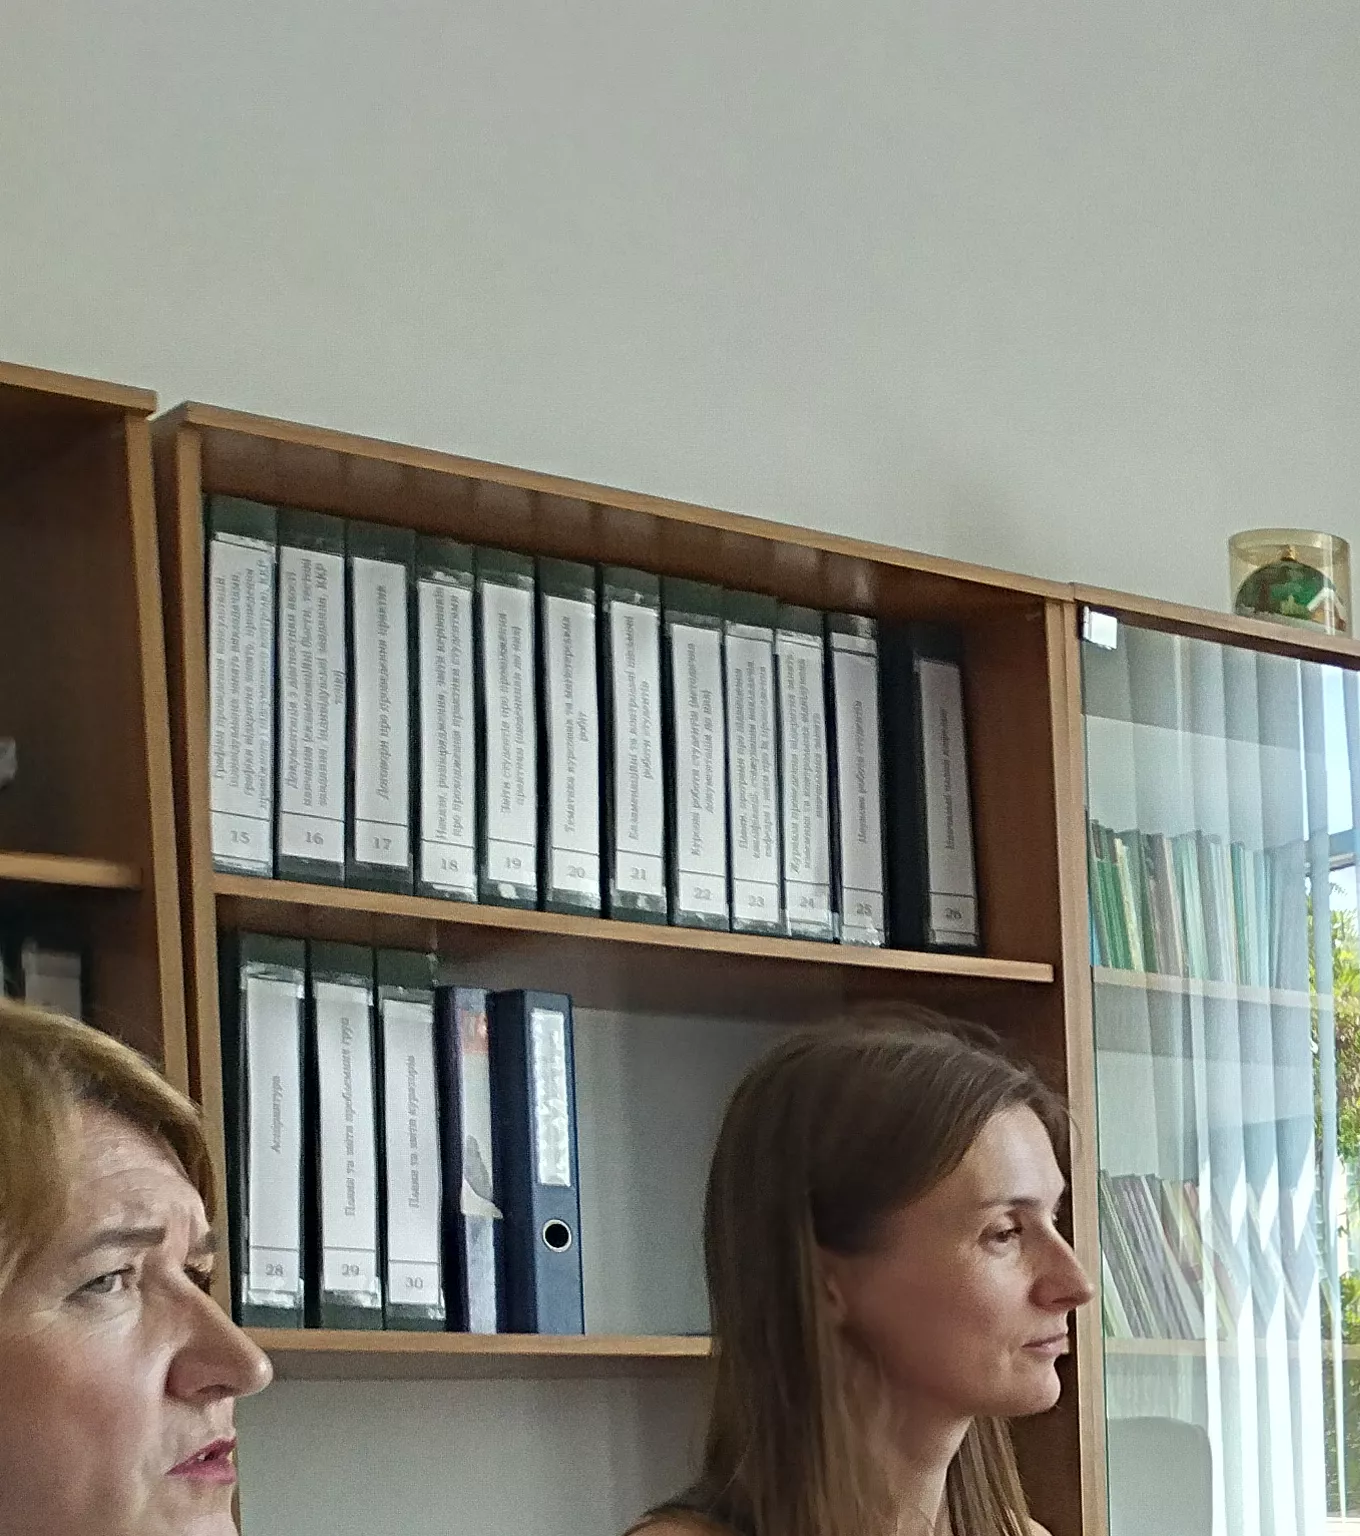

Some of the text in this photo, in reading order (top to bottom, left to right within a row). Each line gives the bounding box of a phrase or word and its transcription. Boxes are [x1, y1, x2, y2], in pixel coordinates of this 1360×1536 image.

[501, 696, 510, 717] про
[378, 714, 390, 737] про
[640, 740, 653, 779] роботи
[376, 740, 391, 799] Договори
[689, 770, 701, 809] роботи
[565, 777, 575, 832] Тематика
[452, 815, 462, 836] про
[230, 830, 251, 844] 15
[305, 831, 325, 846] 16
[372, 836, 392, 851] 17
[440, 858, 459, 872] 18
[505, 856, 523, 870] 19
[566, 864, 586, 880] 20
[630, 867, 647, 880] 21
[693, 887, 711, 900] 22
[857, 903, 873, 916] 25
[271, 1076, 283, 1154] Аспірантура
[408, 1170, 419, 1208] Плани
[345, 1178, 355, 1216] Плани
[265, 1264, 284, 1276] 28
[341, 1264, 360, 1276] 29
[405, 1276, 424, 1289] 30
